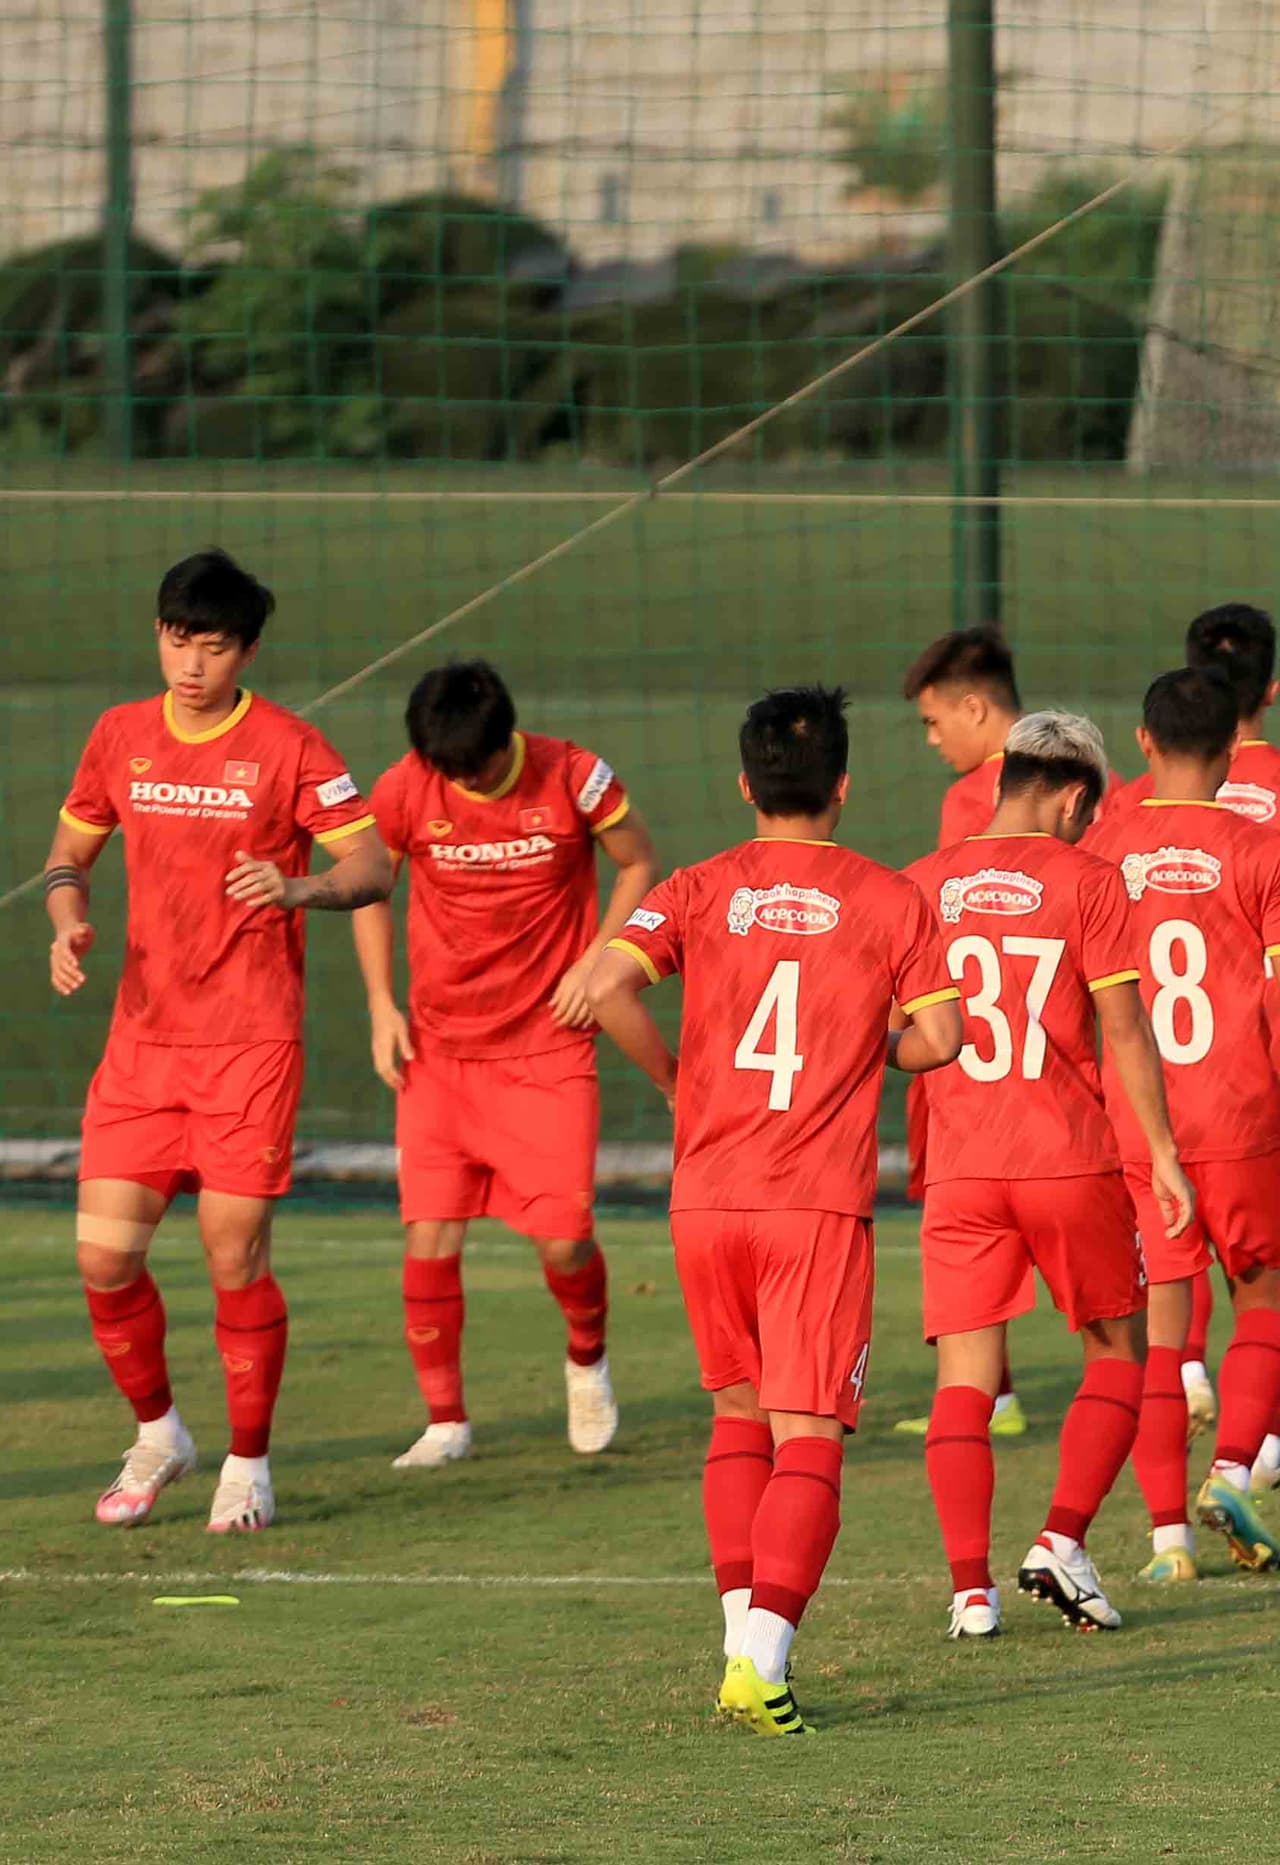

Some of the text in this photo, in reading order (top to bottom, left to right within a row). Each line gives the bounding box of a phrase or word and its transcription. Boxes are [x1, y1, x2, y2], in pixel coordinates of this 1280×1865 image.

[129, 782, 254, 807] HONDA
[152, 804, 186, 816] Power
[202, 808, 248, 820] Dreams
[428, 835, 556, 862] HONDA
[755, 885, 838, 909] Cook happiness
[946, 934, 1066, 1083] 37
[1149, 919, 1214, 1065] 8
[734, 960, 804, 1112] 4
[850, 1343, 868, 1402] 4
